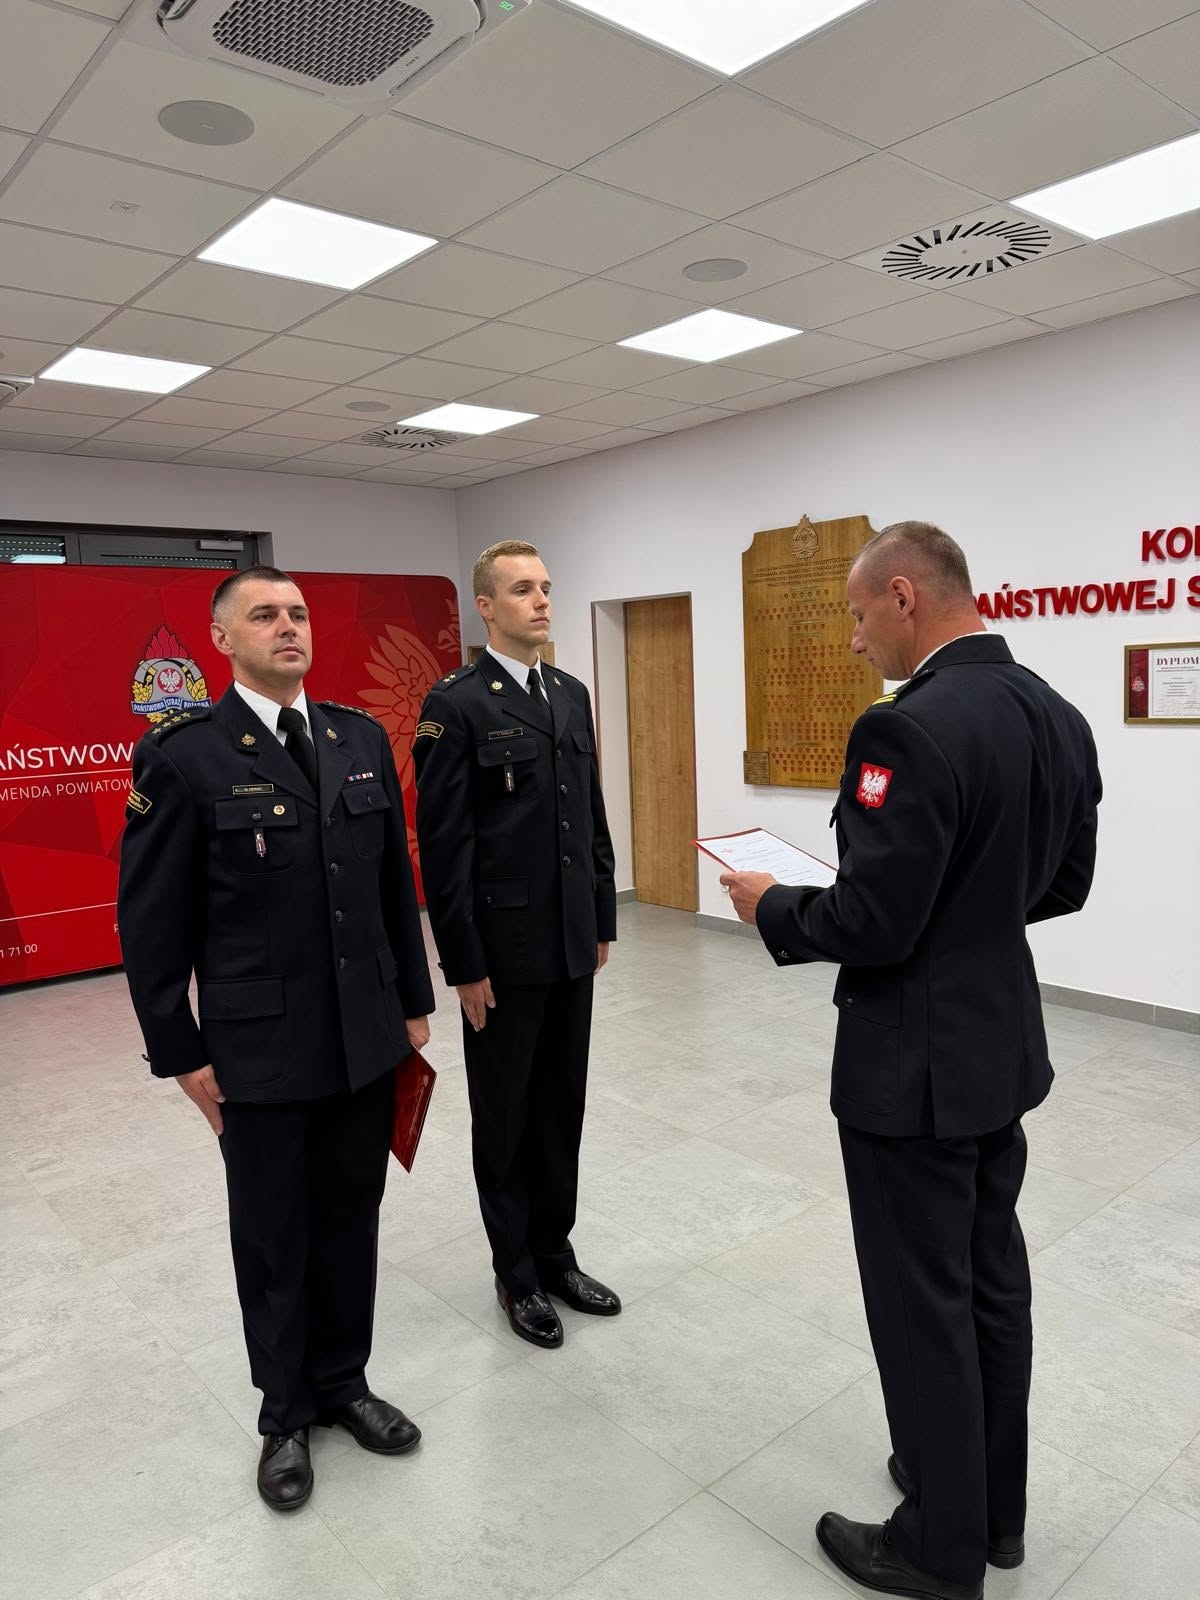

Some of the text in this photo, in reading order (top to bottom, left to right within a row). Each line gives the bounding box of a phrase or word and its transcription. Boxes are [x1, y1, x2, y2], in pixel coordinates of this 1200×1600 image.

[973, 578, 1176, 619] AŃSTWOWEJ
[1156, 656, 1199, 666] DYPLOM
[8, 946, 20, 957] 71
[24, 943, 38, 954] 00
